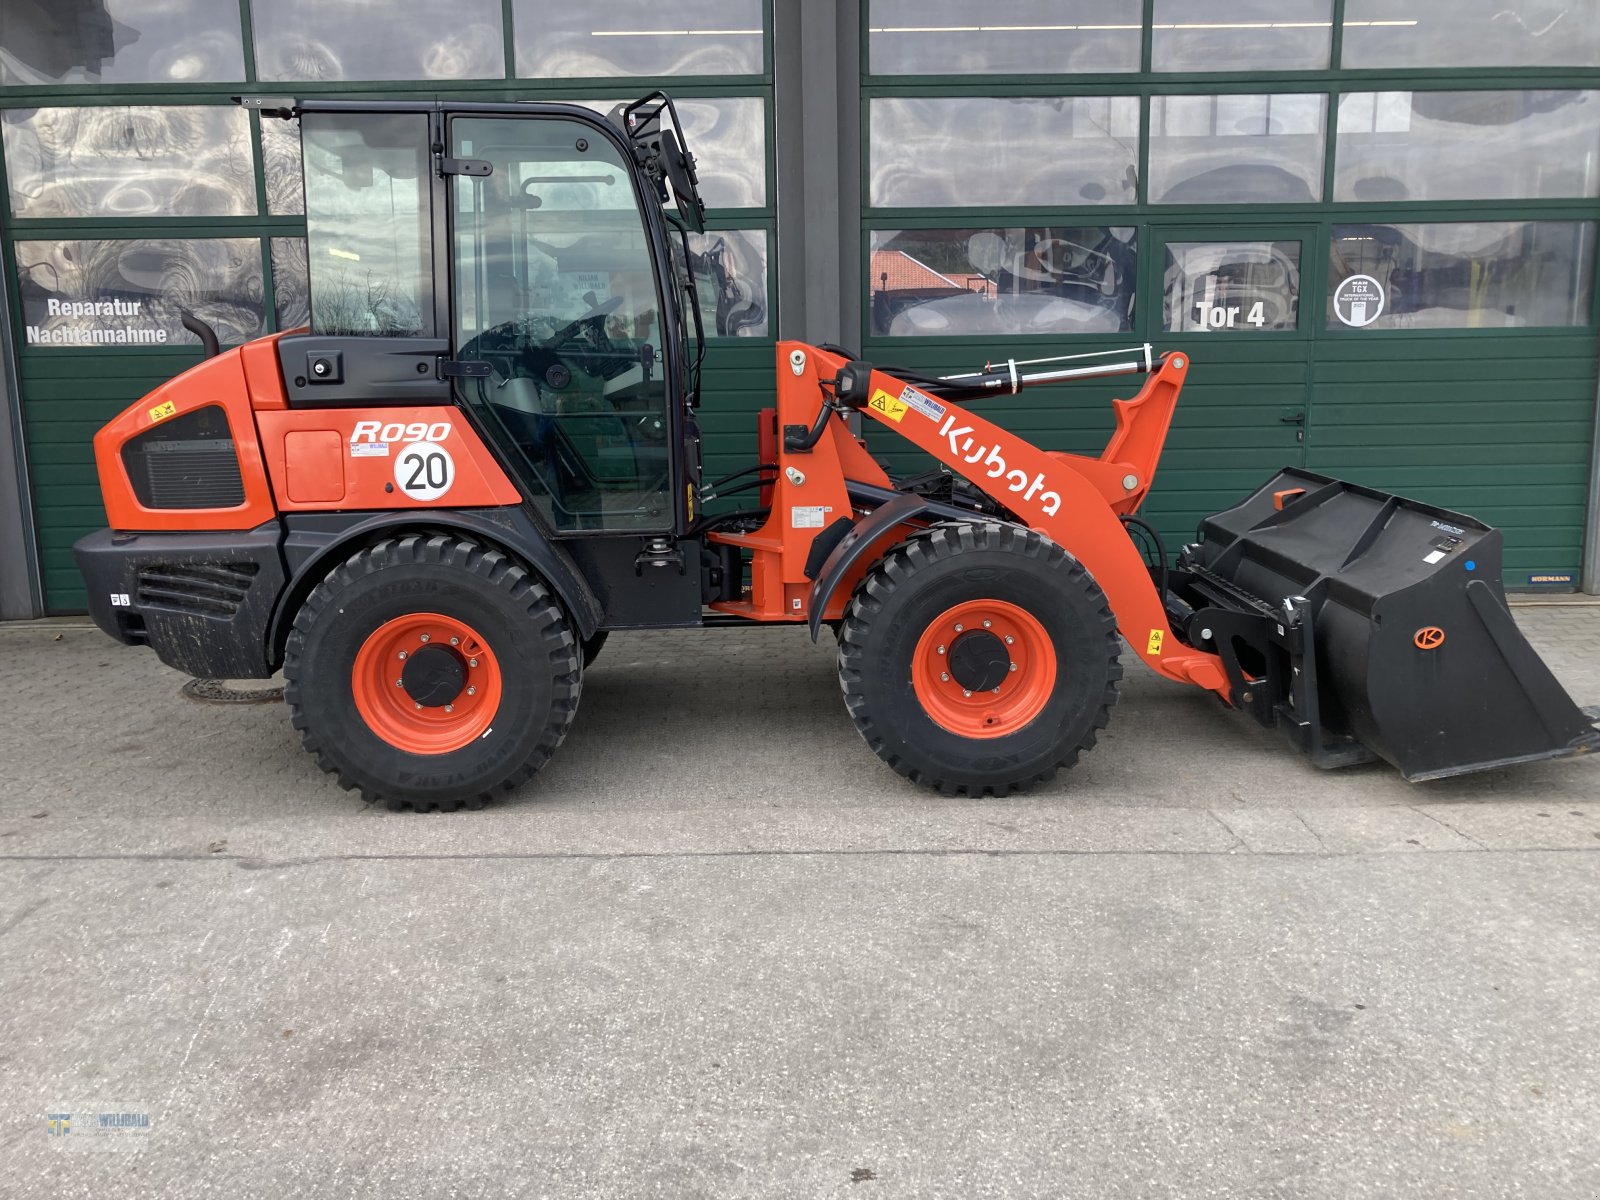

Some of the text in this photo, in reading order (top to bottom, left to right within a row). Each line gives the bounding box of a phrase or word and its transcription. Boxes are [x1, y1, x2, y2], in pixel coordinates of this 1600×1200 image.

[47, 298, 142, 320] Reparatur
[1195, 301, 1265, 328] Tor 4
[26, 325, 167, 344] Nachtannahme
[403, 452, 448, 490] 20
[939, 415, 1061, 517] Kubota
